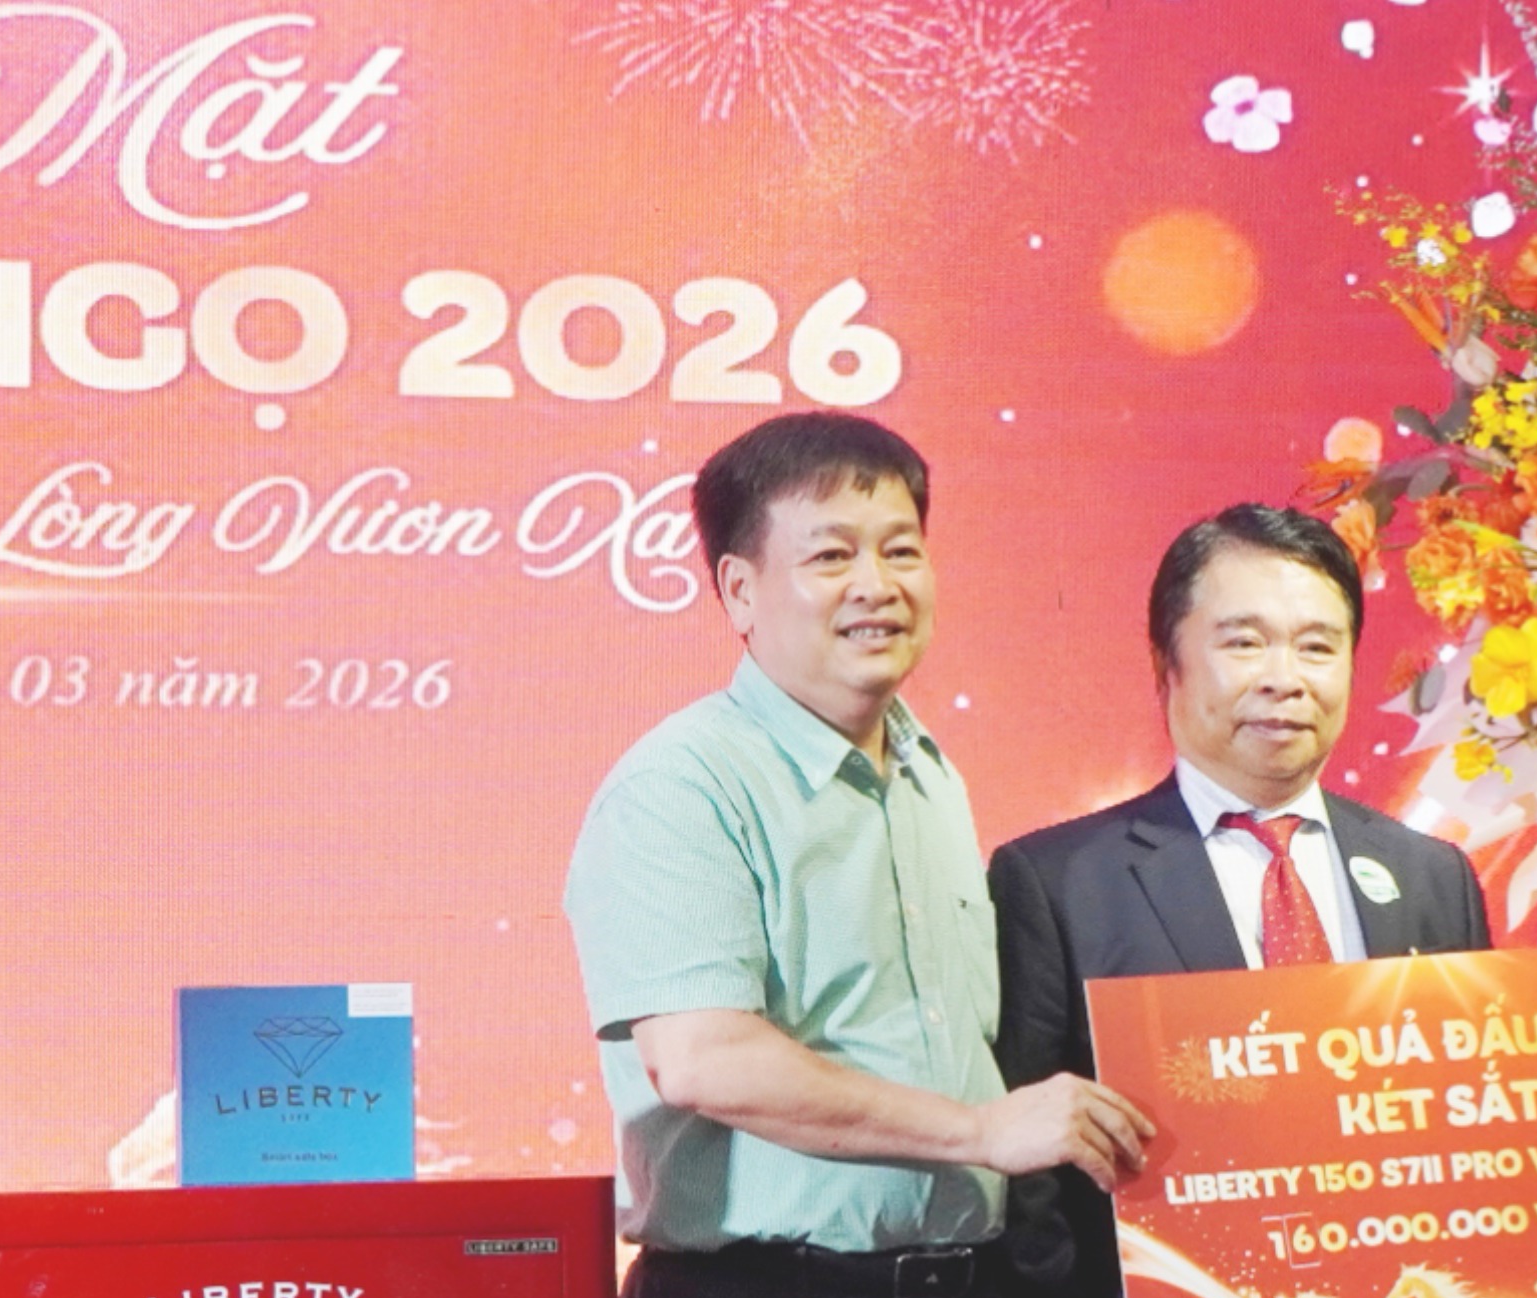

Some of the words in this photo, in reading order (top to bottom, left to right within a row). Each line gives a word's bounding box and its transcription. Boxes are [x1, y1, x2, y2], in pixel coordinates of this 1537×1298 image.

[398, 268, 902, 407] 2026
[213, 467, 501, 574] Vươn
[9, 655, 92, 706] 03
[117, 657, 259, 708] năm
[282, 658, 455, 709] 2026
[1208, 1010, 1307, 1080] KẾT
[1316, 1008, 1435, 1082] QUẢ
[215, 1085, 382, 1115] LIBERTY
[1336, 1077, 1436, 1137] KÉT
[1164, 1165, 1303, 1205] LIBERTY
[1309, 1160, 1374, 1194] 150
[1450, 1146, 1523, 1183] PRO
[1267, 1204, 1530, 1260] 160.000.000
